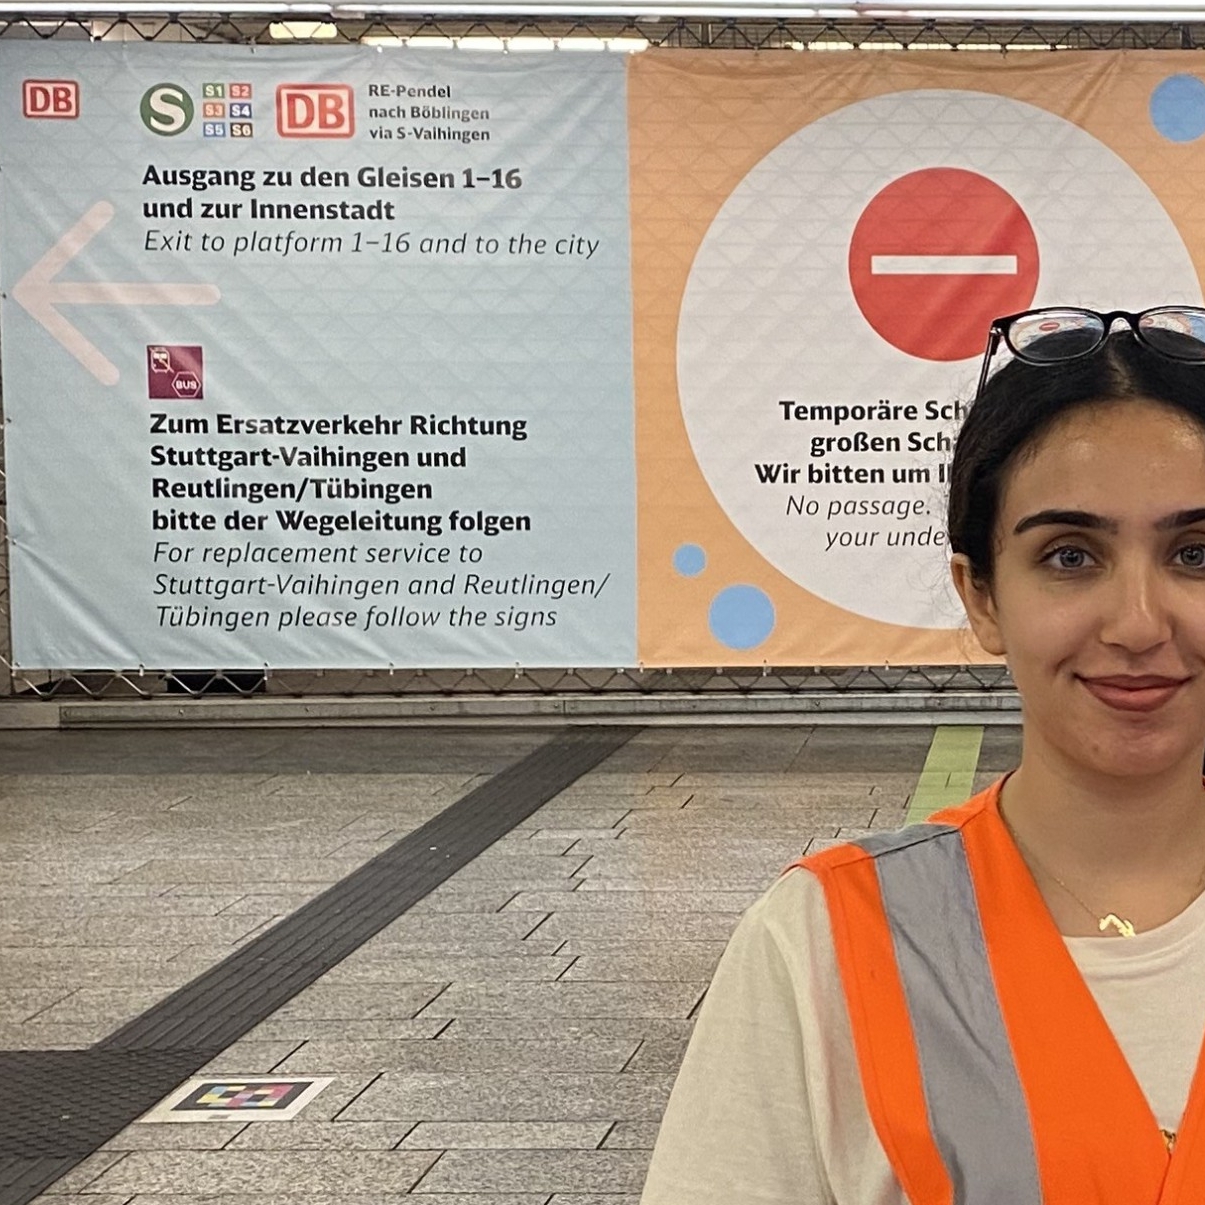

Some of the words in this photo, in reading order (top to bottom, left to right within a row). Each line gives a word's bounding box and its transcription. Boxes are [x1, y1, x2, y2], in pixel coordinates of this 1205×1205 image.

[30, 86, 72, 112] DB
[206, 86, 223, 96] S1
[232, 87, 249, 97] S2
[369, 85, 450, 98] RE-Pendel
[150, 88, 186, 132] S
[206, 105, 223, 116] S3
[232, 106, 250, 116] S4
[286, 93, 345, 129] DB
[369, 106, 405, 118] nach
[411, 106, 489, 122] Böblingen
[206, 125, 224, 135] S5
[232, 125, 250, 135] S6
[370, 126, 392, 139] via
[397, 127, 490, 144] S-Vaihingen
[142, 165, 255, 191] Ausgang
[263, 171, 292, 186] zu
[301, 166, 349, 187] den
[358, 166, 454, 188] Gleisen
[463, 168, 522, 189] 1–16
[144, 197, 192, 218] und
[201, 203, 242, 218] zur
[251, 199, 395, 220] Innenstadt
[145, 230, 192, 251] Exit
[202, 234, 224, 251] to
[234, 231, 342, 256] platform
[352, 232, 410, 253] 1–16
[420, 233, 467, 253] and
[476, 236, 498, 253] to
[509, 233, 546, 254] the
[556, 234, 599, 259] city
[176, 380, 197, 390] BUS
[779, 400, 918, 425] Temporäre
[150, 414, 208, 434] Zum
[217, 414, 402, 435] Ersatzverkehr
[411, 414, 527, 440] Richtung
[811, 432, 900, 457] großen
[151, 445, 409, 472] Stuttgart-Vaihingen
[417, 447, 466, 467] und
[755, 463, 800, 483] Wir
[809, 463, 884, 483] bitten
[893, 469, 930, 483] um
[153, 477, 432, 504] Reutlingen/Tübingen
[787, 495, 819, 515] No
[827, 500, 930, 520] passage.
[153, 509, 216, 530] bitte
[224, 510, 268, 530] der
[276, 510, 442, 536] Wegeleitung
[449, 510, 530, 536] folgen
[826, 532, 879, 551] your
[154, 542, 194, 562] For
[203, 542, 358, 567] replacement
[365, 543, 450, 563] service
[460, 546, 482, 563] to
[153, 574, 398, 600] Stuttgart-Vaihingen
[409, 574, 455, 594] and
[464, 573, 610, 599] Reutlingen/
[157, 605, 269, 632] Tübingen
[278, 606, 357, 631] please
[364, 606, 440, 631] follow
[450, 606, 487, 626] the
[495, 606, 557, 631] signs
